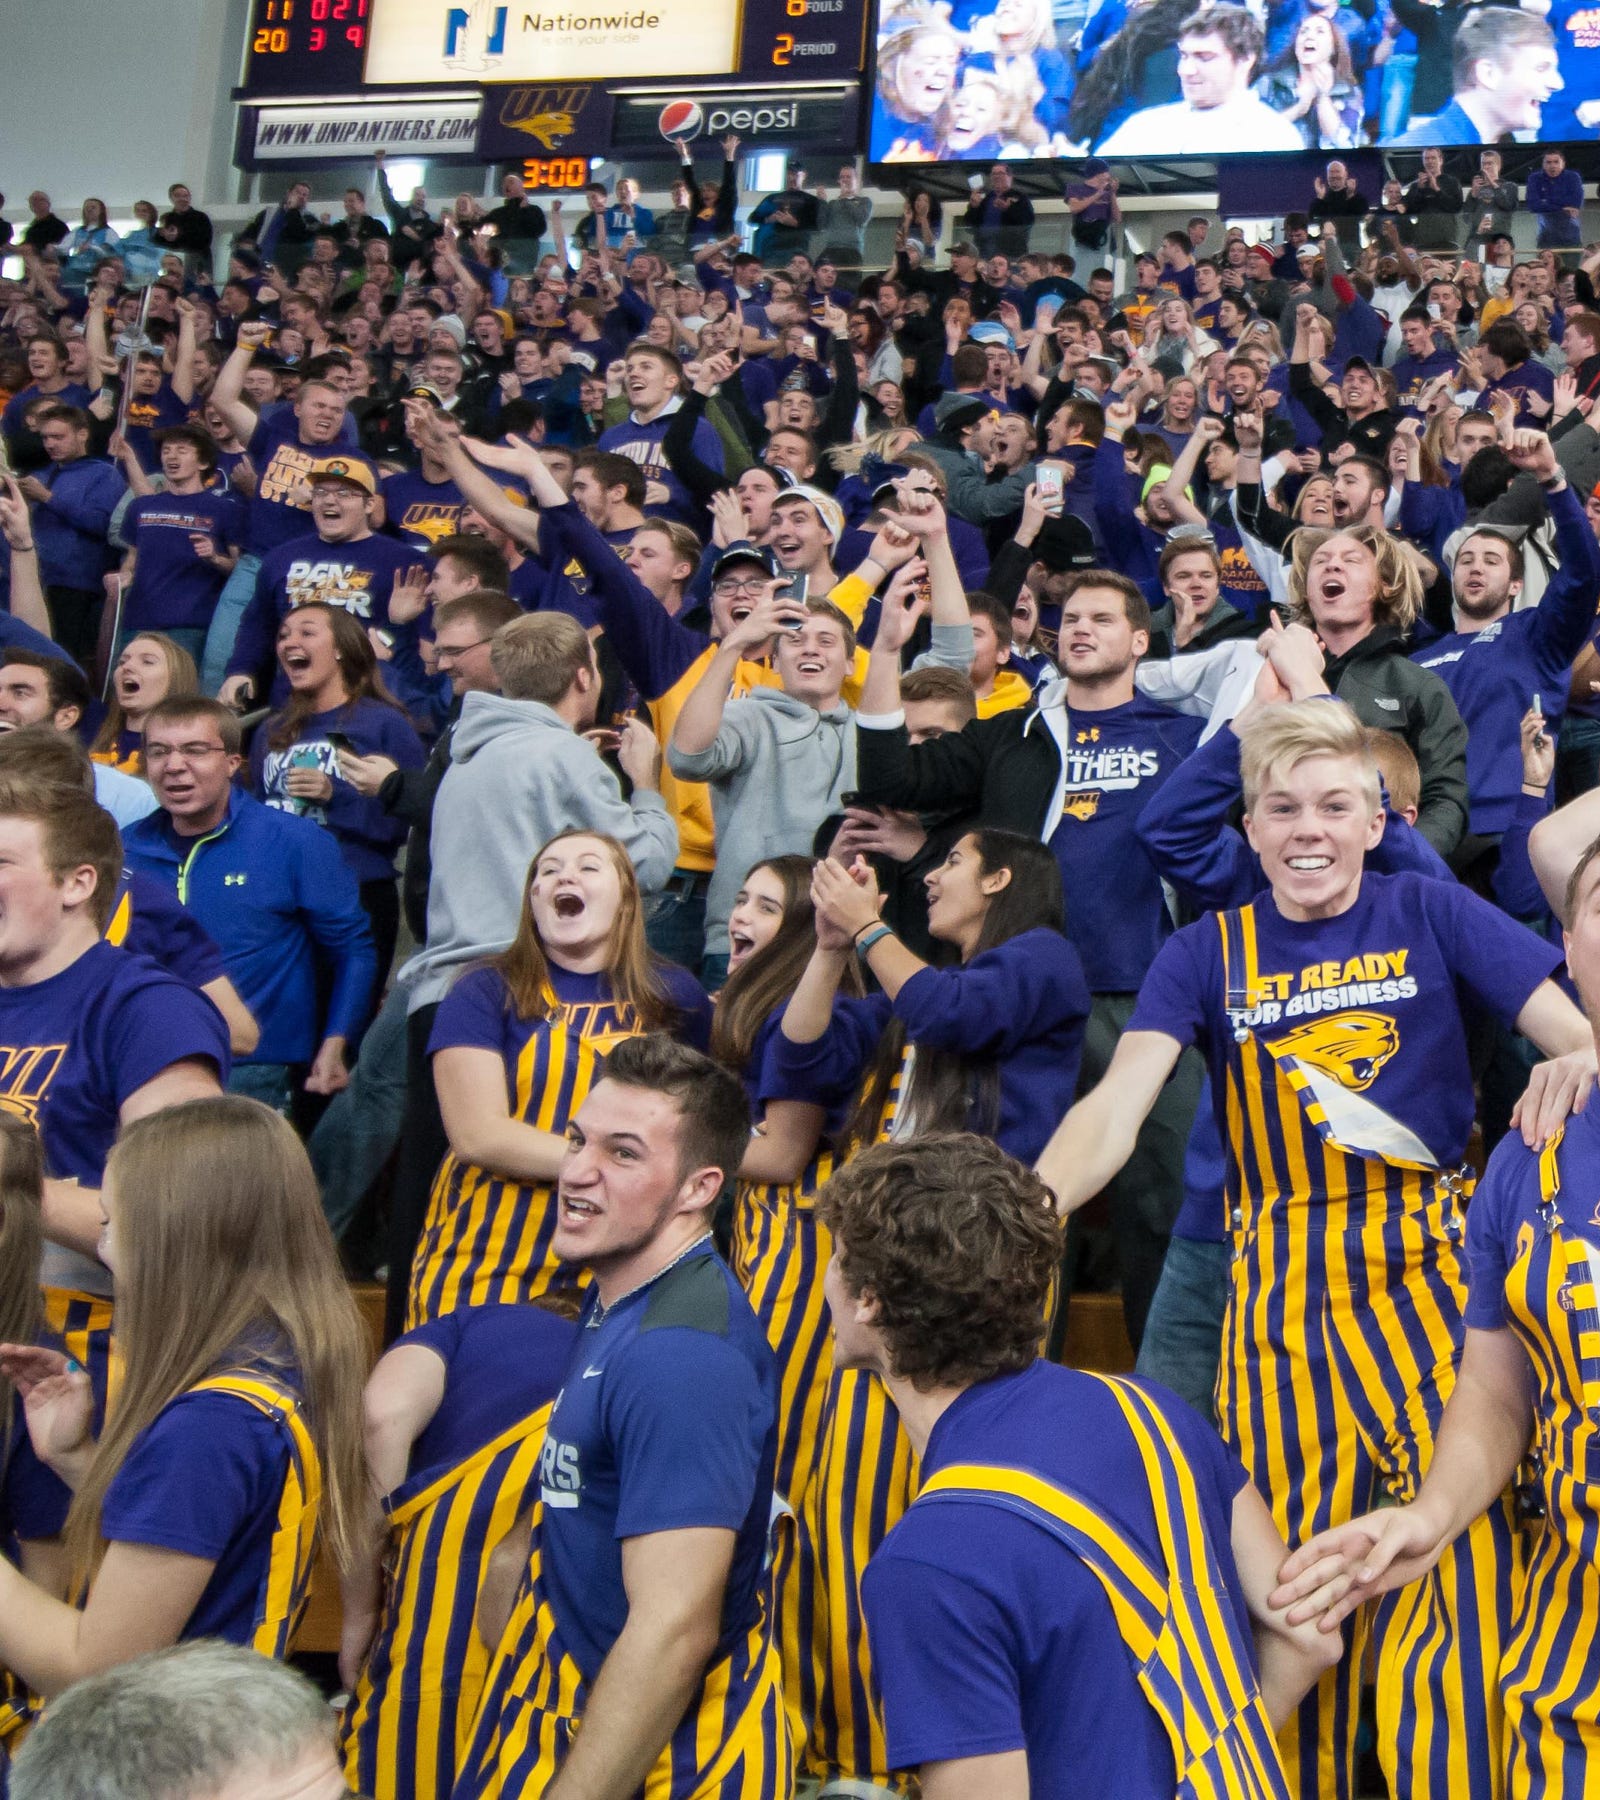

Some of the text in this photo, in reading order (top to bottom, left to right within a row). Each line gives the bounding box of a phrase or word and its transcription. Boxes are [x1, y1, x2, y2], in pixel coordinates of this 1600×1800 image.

[806, 0, 843, 13] FOULS
[523, 11, 660, 33] Nationwide
[254, 28, 289, 53] 20
[309, 28, 326, 51] 3
[346, 26, 364, 48] 9
[772, 33, 794, 66] 2
[793, 43, 836, 56] PERIOD
[501, 87, 592, 125] UNI
[708, 104, 798, 135] pepsi
[258, 118, 478, 146] WWW.UNIPANTHERS.COM
[522, 158, 588, 189] 3:00
[1067, 749, 1159, 782] THERS
[1257, 949, 1409, 1002] ET READY
[1285, 976, 1419, 1017] BUSINESS
